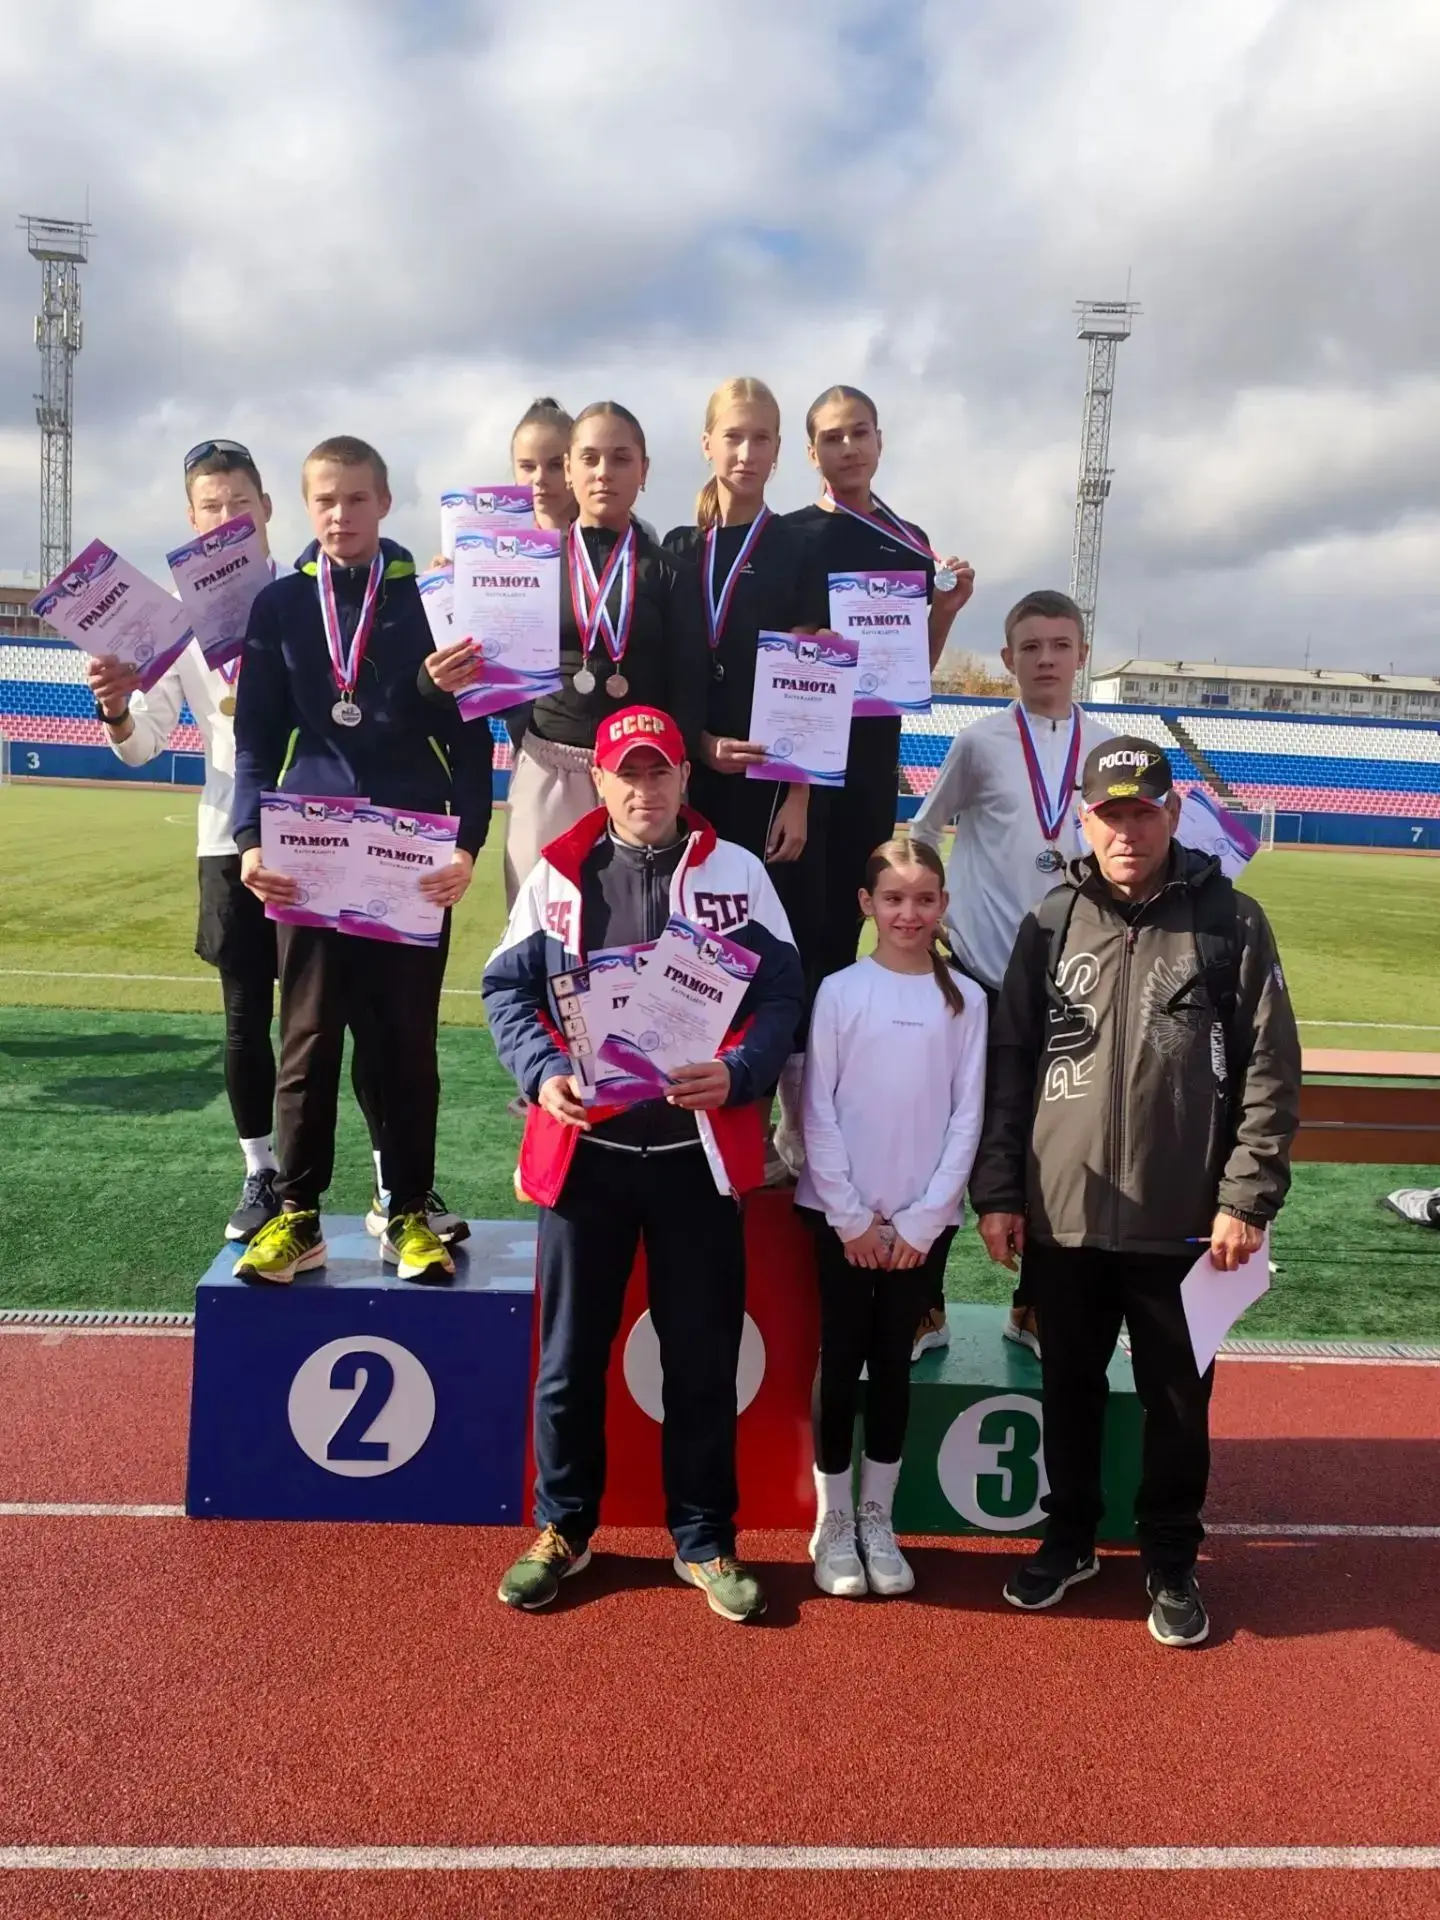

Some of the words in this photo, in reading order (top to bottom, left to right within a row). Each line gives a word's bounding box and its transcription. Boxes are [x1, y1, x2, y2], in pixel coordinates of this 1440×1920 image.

[194, 555, 250, 591] ГРАМОТА
[472, 576, 540, 588] ГРАМОТА
[77, 581, 130, 631] ГРАМОТА
[848, 614, 912, 627] ГРАМОТА
[772, 677, 837, 695] ГРАМОТА
[609, 713, 665, 742] СССР
[26, 752, 41, 769] 3
[1098, 750, 1150, 773] РОССИЯ
[280, 834, 349, 848] ГРАМОТА
[1410, 827, 1425, 843] 7
[367, 845, 435, 866] ГРАМОТА
[663, 964, 724, 1004] ГРАМОТА
[1044, 952, 1101, 1102] RUS
[326, 1350, 395, 1461] 2
[974, 1410, 1041, 1518] 3
